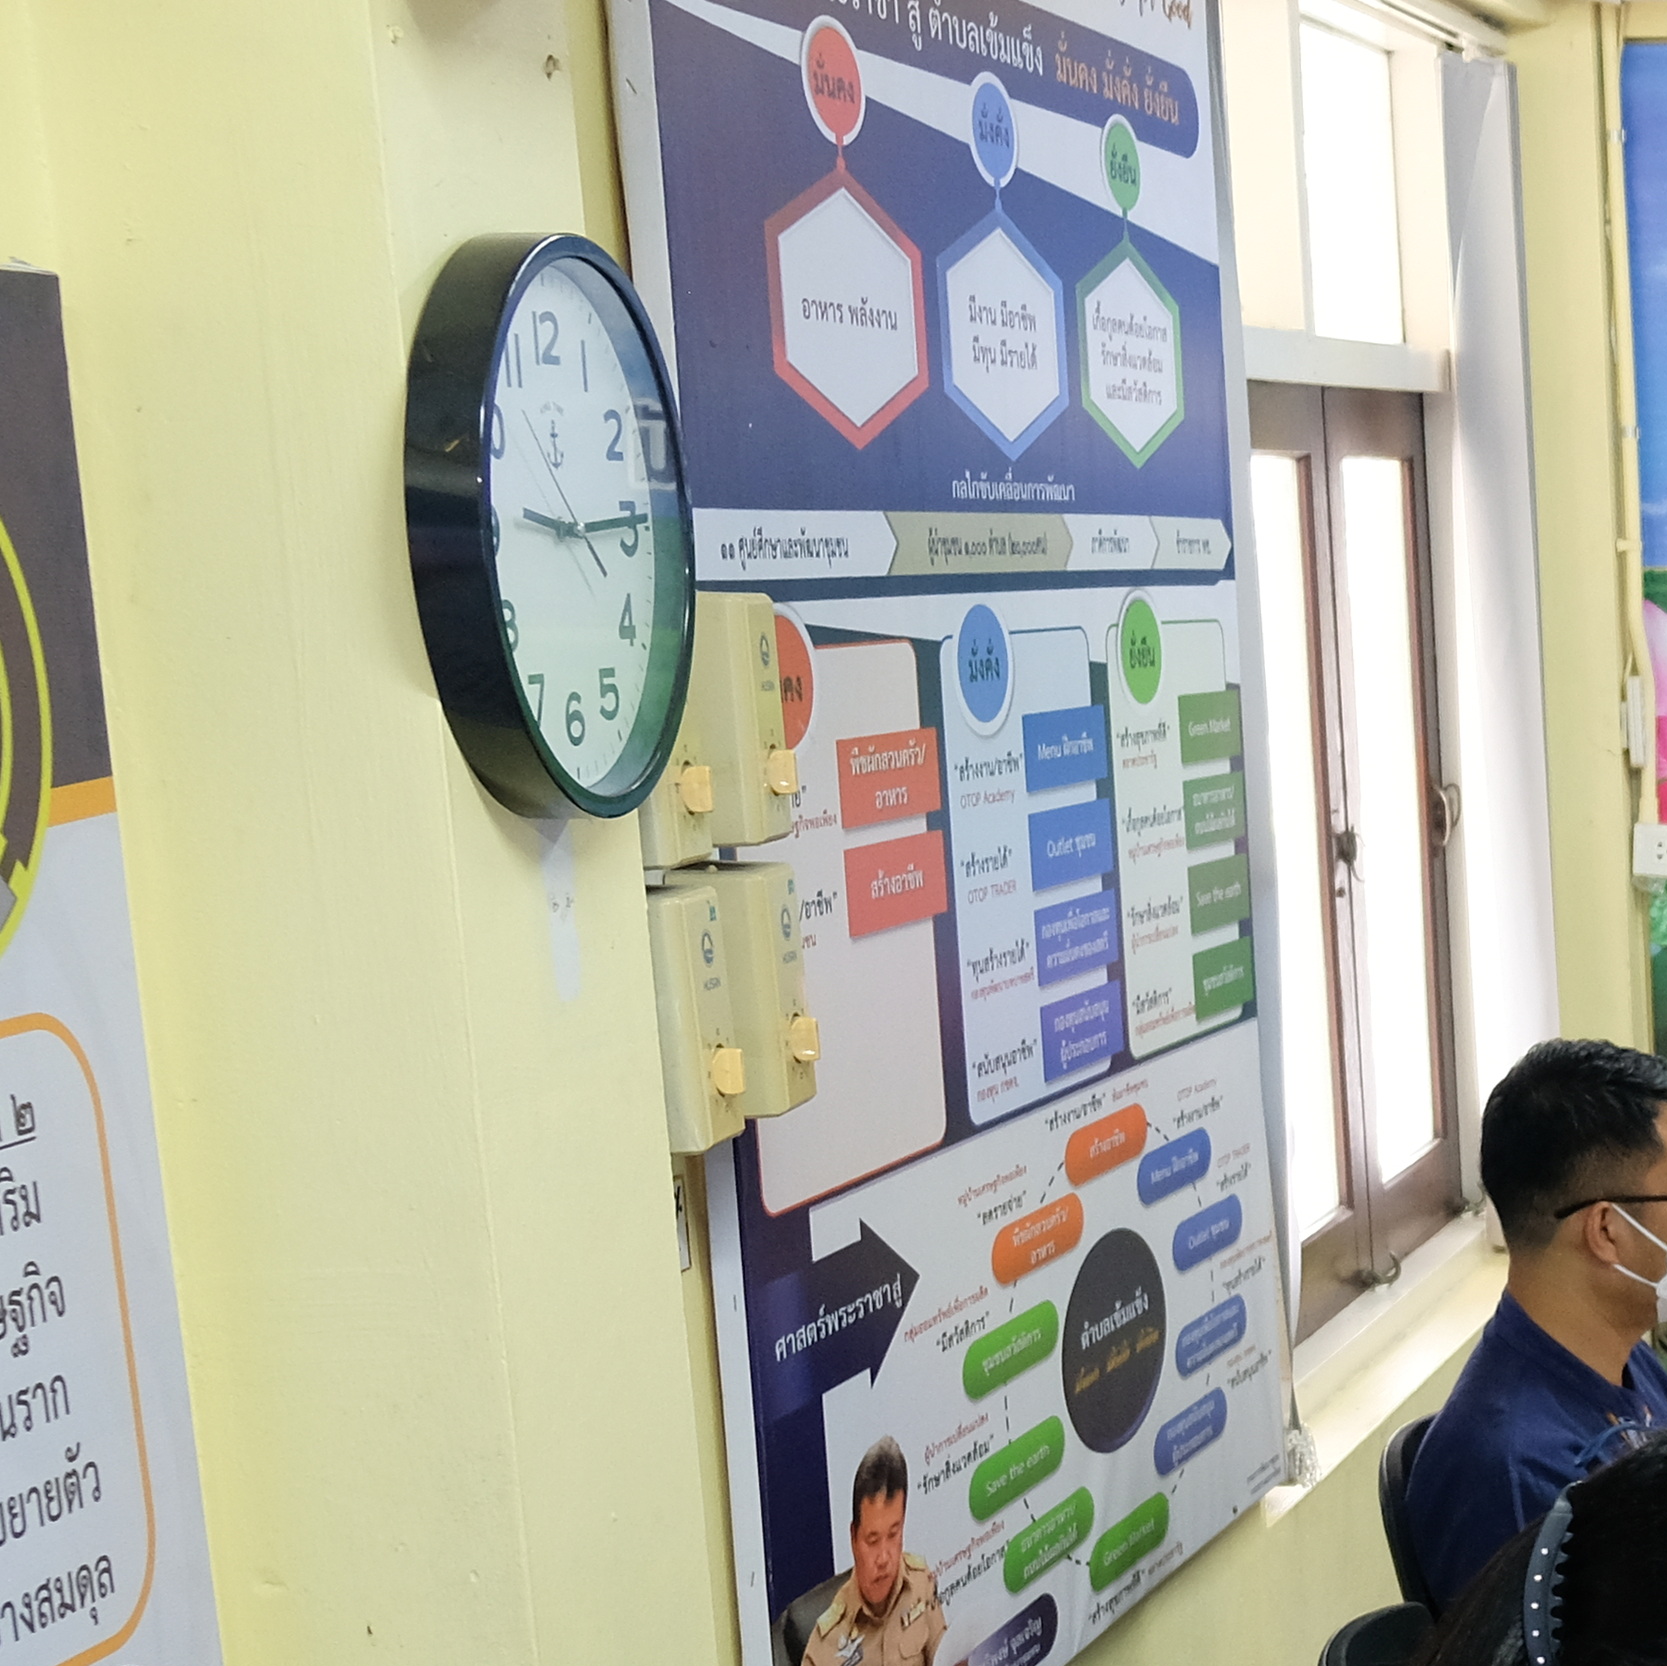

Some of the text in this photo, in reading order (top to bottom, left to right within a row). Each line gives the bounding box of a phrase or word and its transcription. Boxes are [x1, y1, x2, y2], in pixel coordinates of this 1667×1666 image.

[813, 52, 855, 104] มั่นคง
[978, 103, 1010, 148] มั่งคั่ง
[532, 311, 561, 366] 12
[801, 298, 898, 332] อาหาร พลังงาน
[504, 333, 523, 389] 11
[580, 340, 588, 393] 1
[603, 409, 625, 462] 2
[619, 501, 639, 557] 3
[501, 599, 519, 653] 8
[619, 592, 636, 647] 4
[968, 639, 1000, 682] มั่งคั่ง
[1129, 631, 1155, 669] ยั่งยืน
[528, 673, 544, 731] 7
[565, 691, 586, 747] 6
[599, 667, 619, 721] 5
[875, 785, 908, 809] อาหาร
[871, 863, 925, 900] สร้างอาชีพ
[775, 1272, 903, 1362] ศาสตร์พระราชาสู่
[1081, 1285, 1149, 1350] ตำบลเข้มแข็ง
[985, 1445, 1050, 1497] Save the earth
